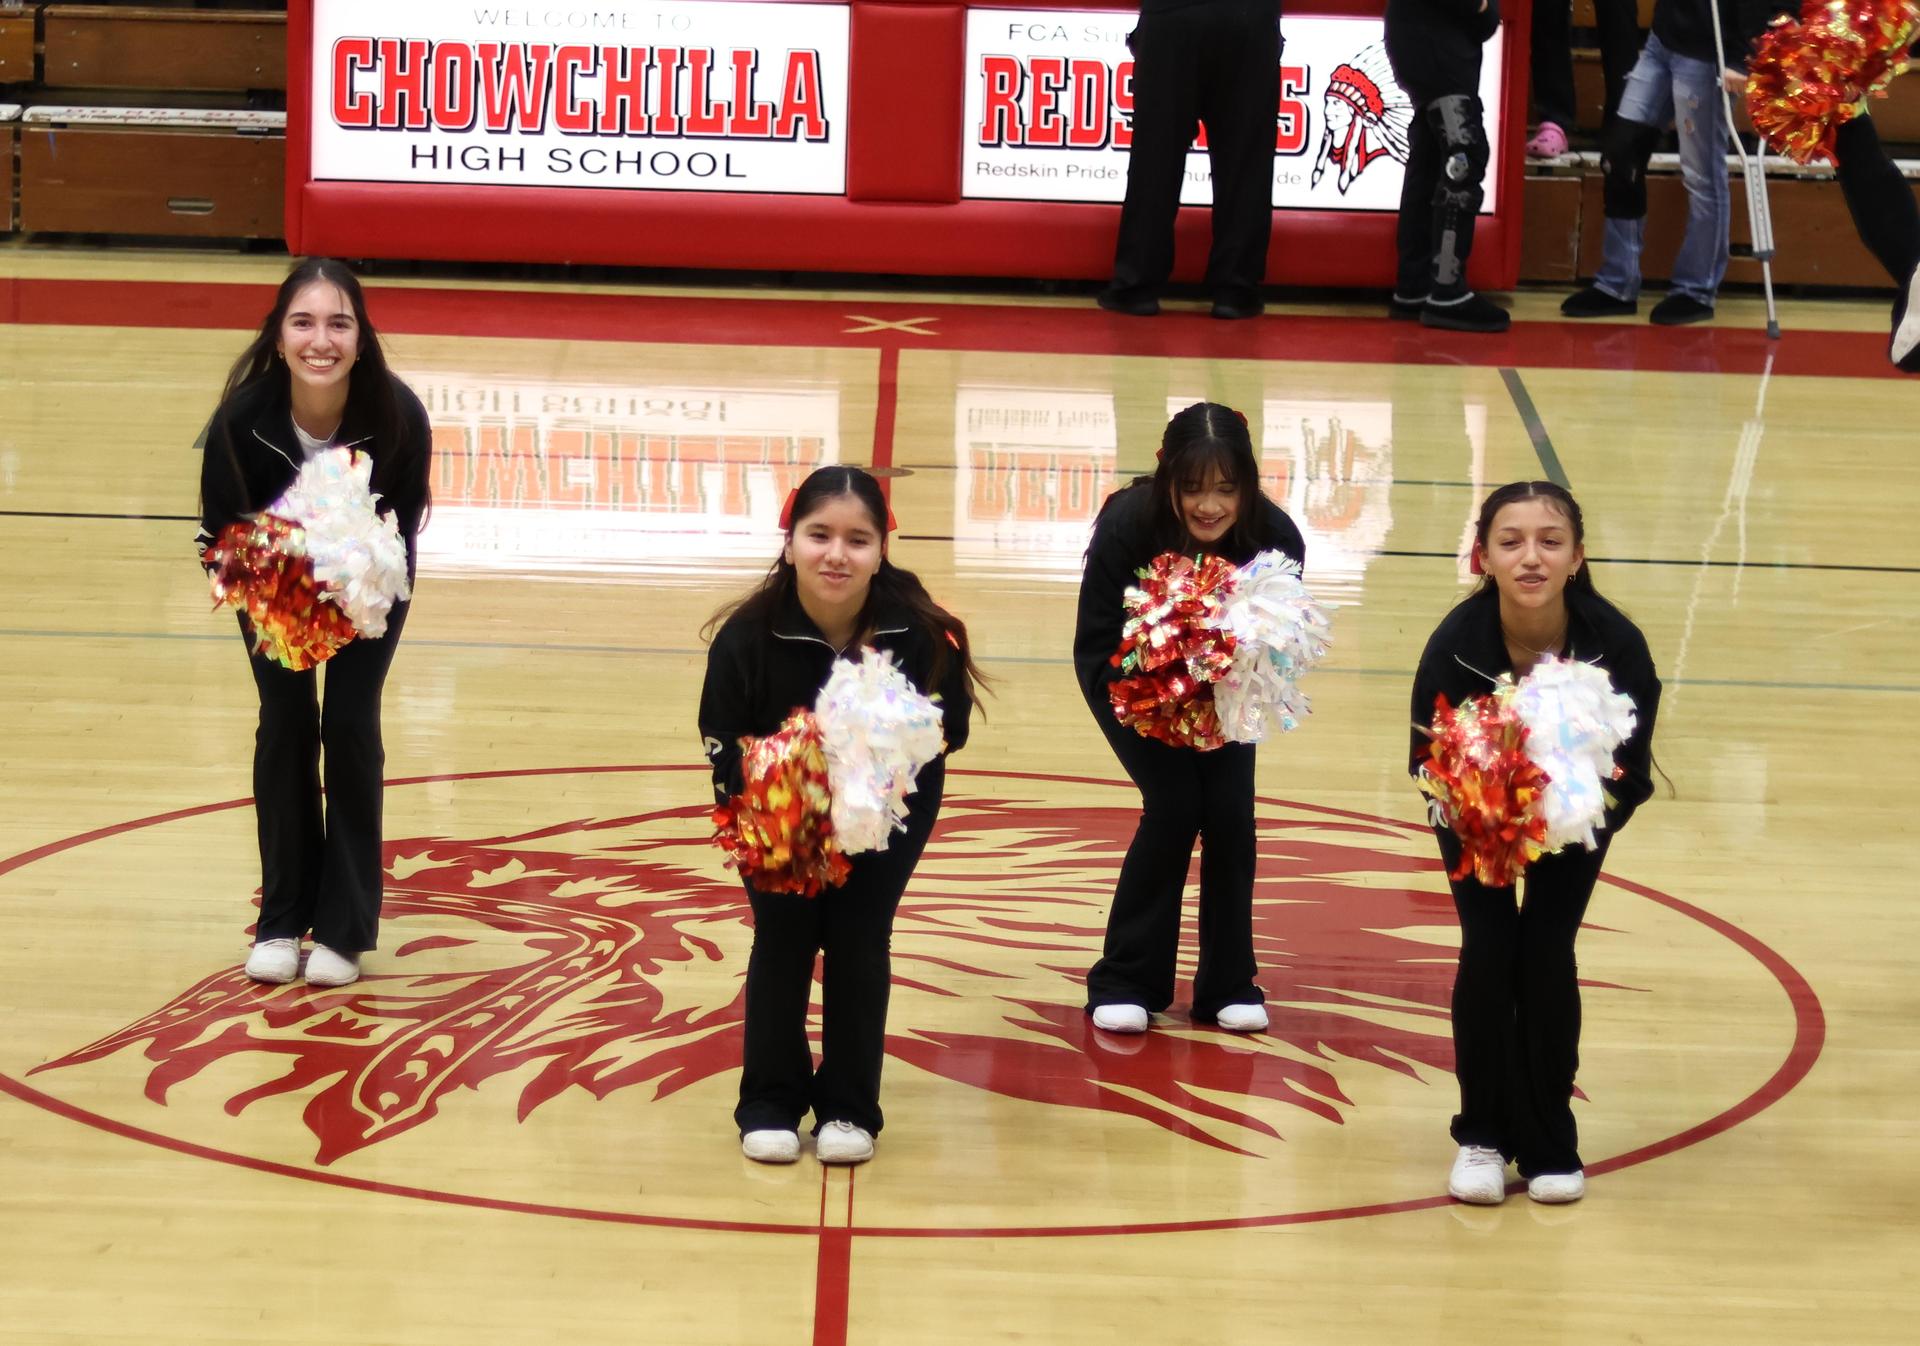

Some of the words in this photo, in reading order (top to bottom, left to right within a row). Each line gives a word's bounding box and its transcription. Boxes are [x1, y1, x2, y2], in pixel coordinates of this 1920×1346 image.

[473, 8, 638, 29] WELCOME
[655, 13, 691, 31] TO
[1008, 23, 1069, 42] FCA
[1083, 25, 1119, 43] Su
[331, 37, 829, 143] CHOWCHILLA
[978, 54, 1311, 156] REDSS
[411, 144, 525, 172] HIGH
[547, 148, 747, 178] SCHOOL
[976, 161, 1059, 178] Redskin
[1066, 164, 1119, 180] Pride
